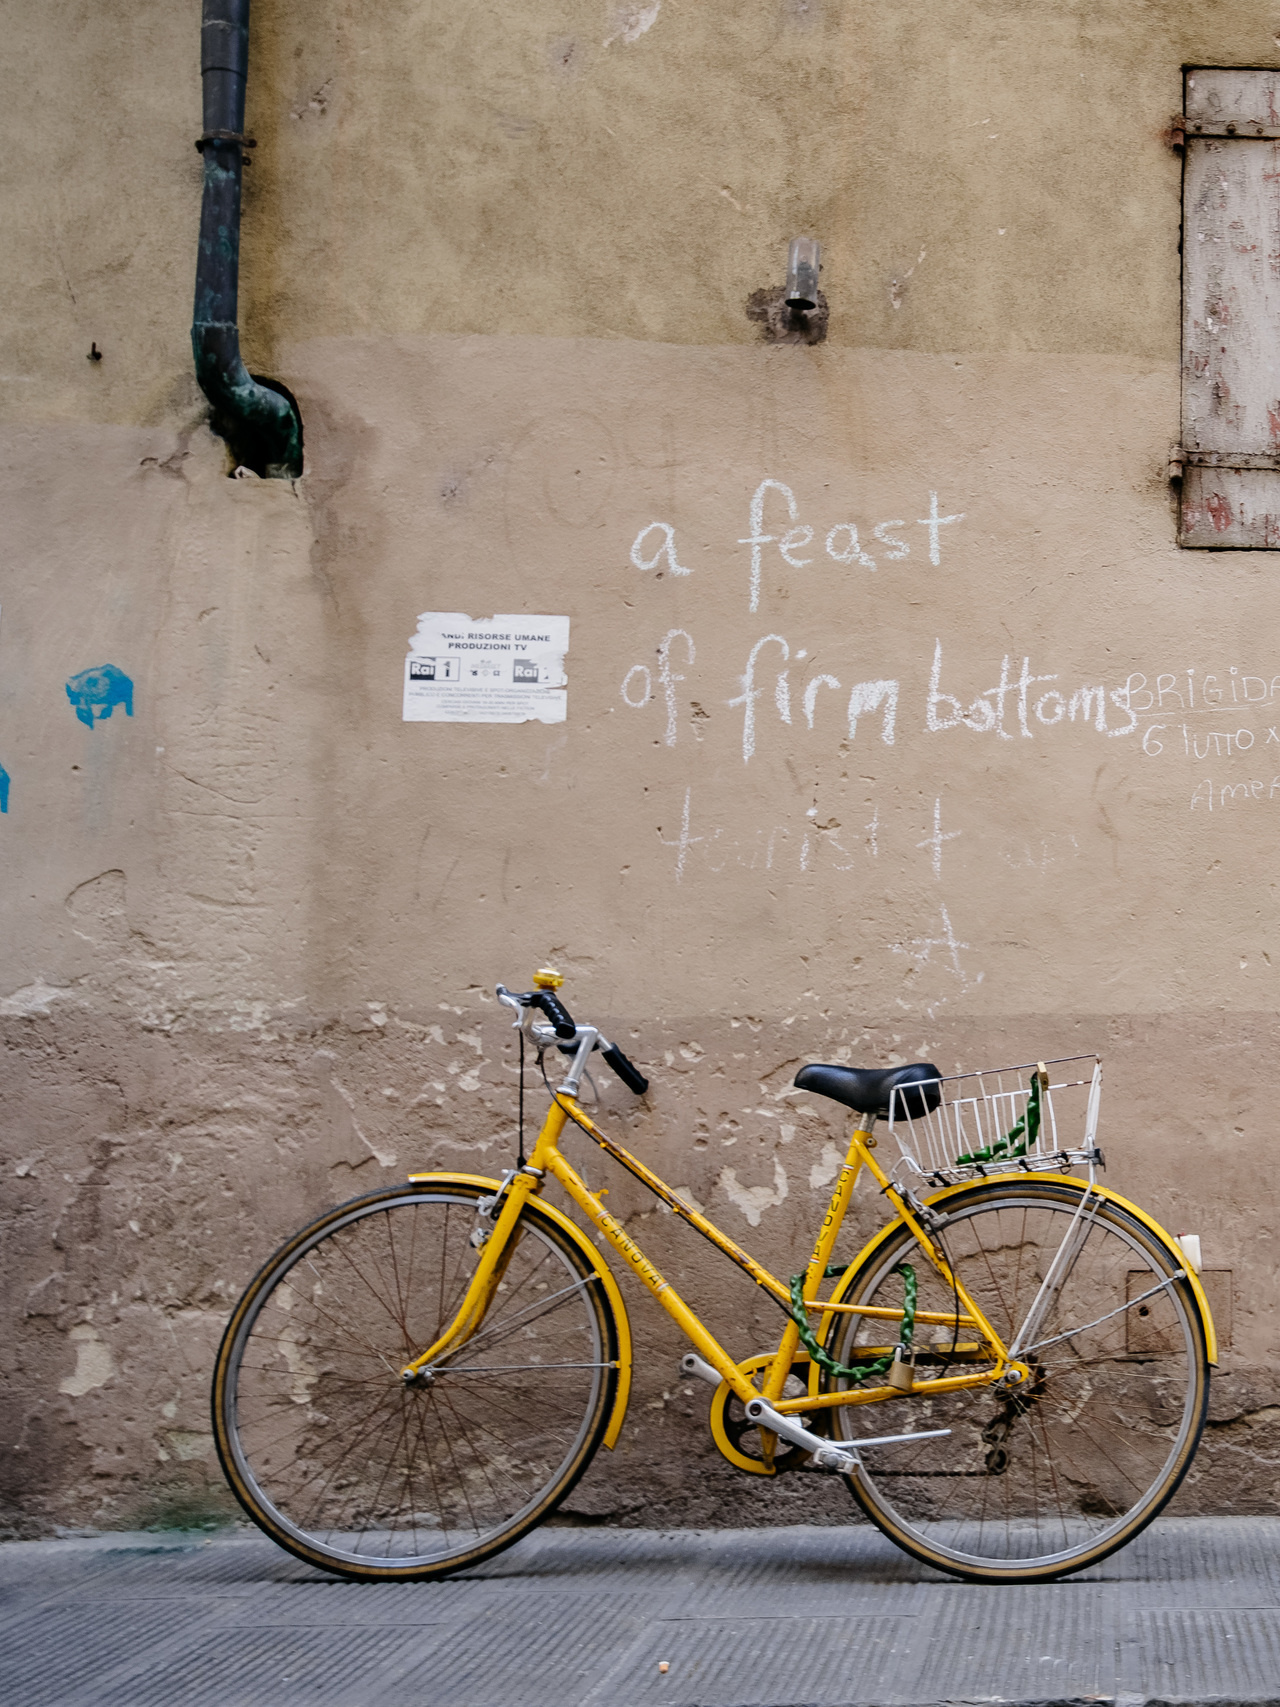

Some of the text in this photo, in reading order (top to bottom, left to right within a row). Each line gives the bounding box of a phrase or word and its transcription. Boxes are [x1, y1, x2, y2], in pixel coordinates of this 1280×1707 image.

[630, 478, 966, 613] a feast
[448, 642, 528, 651] PRODUZIONI TV
[467, 632, 511, 641] RISORSE
[514, 634, 551, 642] UMANE
[620, 628, 1139, 765] of firm bottoms
[600, 1215, 663, 1286] CANOVA
